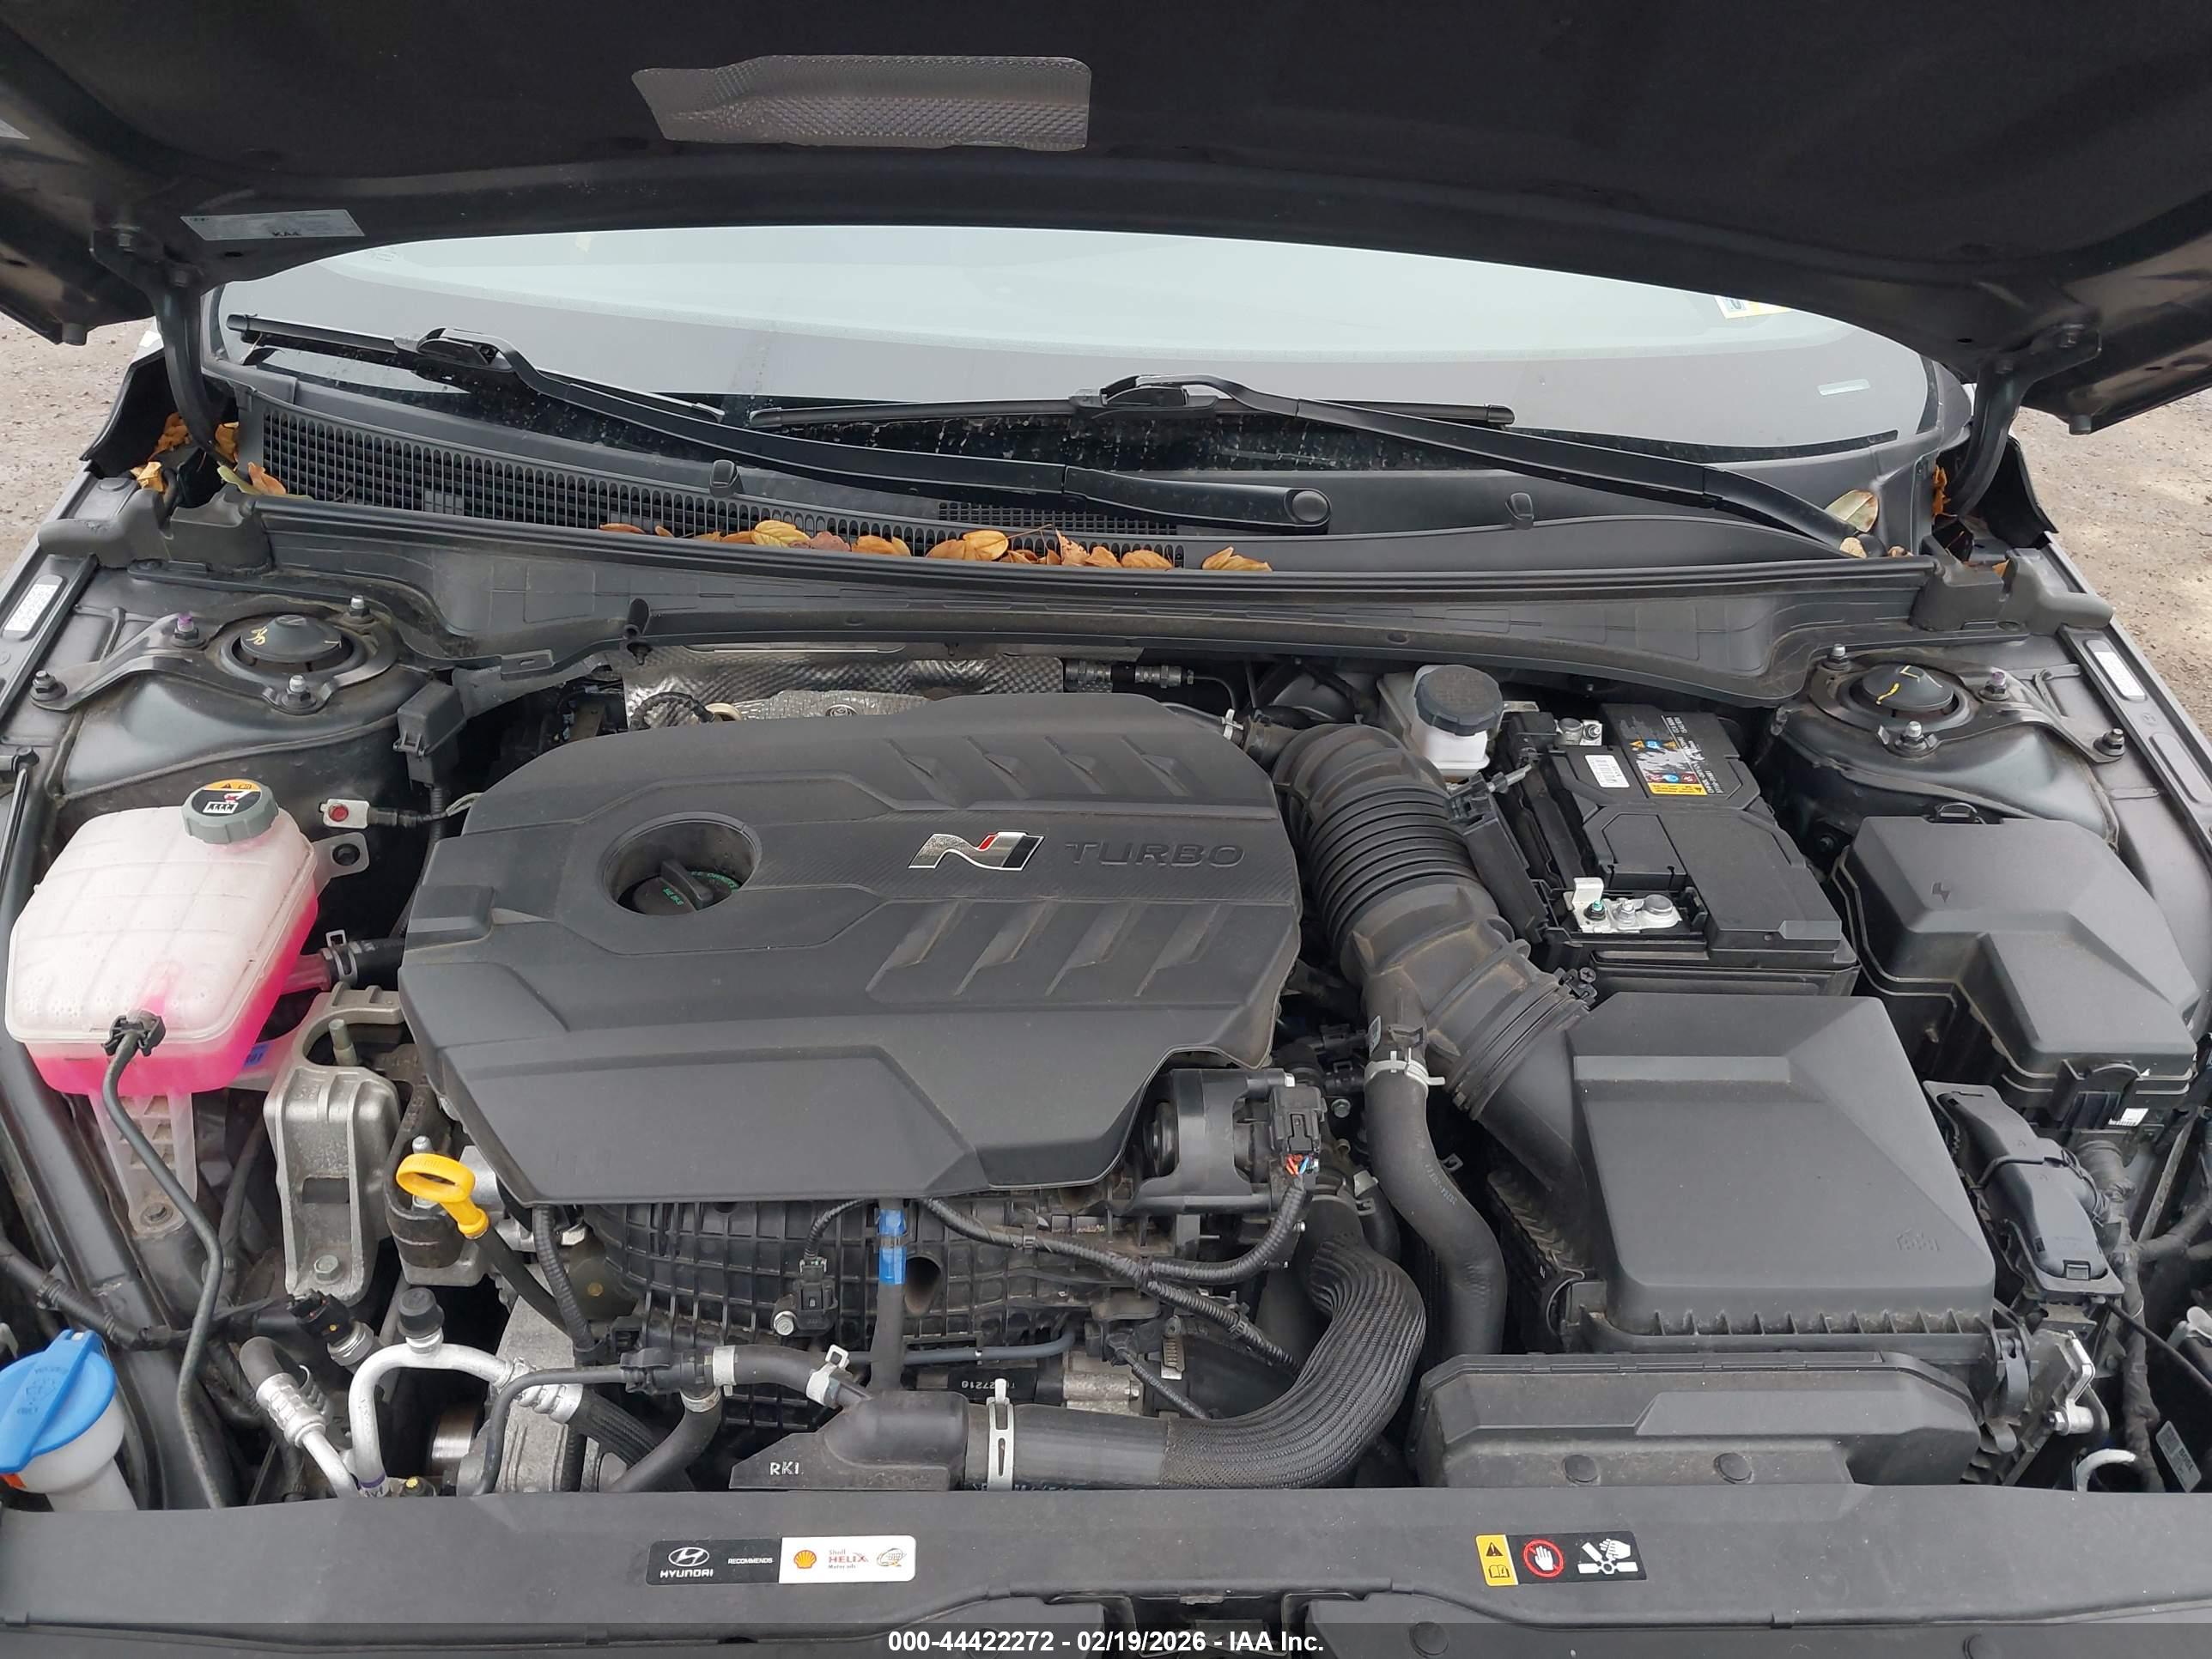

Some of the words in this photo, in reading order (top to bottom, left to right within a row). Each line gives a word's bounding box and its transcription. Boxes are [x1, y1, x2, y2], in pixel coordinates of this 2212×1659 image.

[1064, 840, 1247, 869] TURBO
[727, 1557, 774, 1565] RECOMMENDS
[828, 1554, 866, 1564] HELIX
[659, 1568, 714, 1579] HYUNDAI
